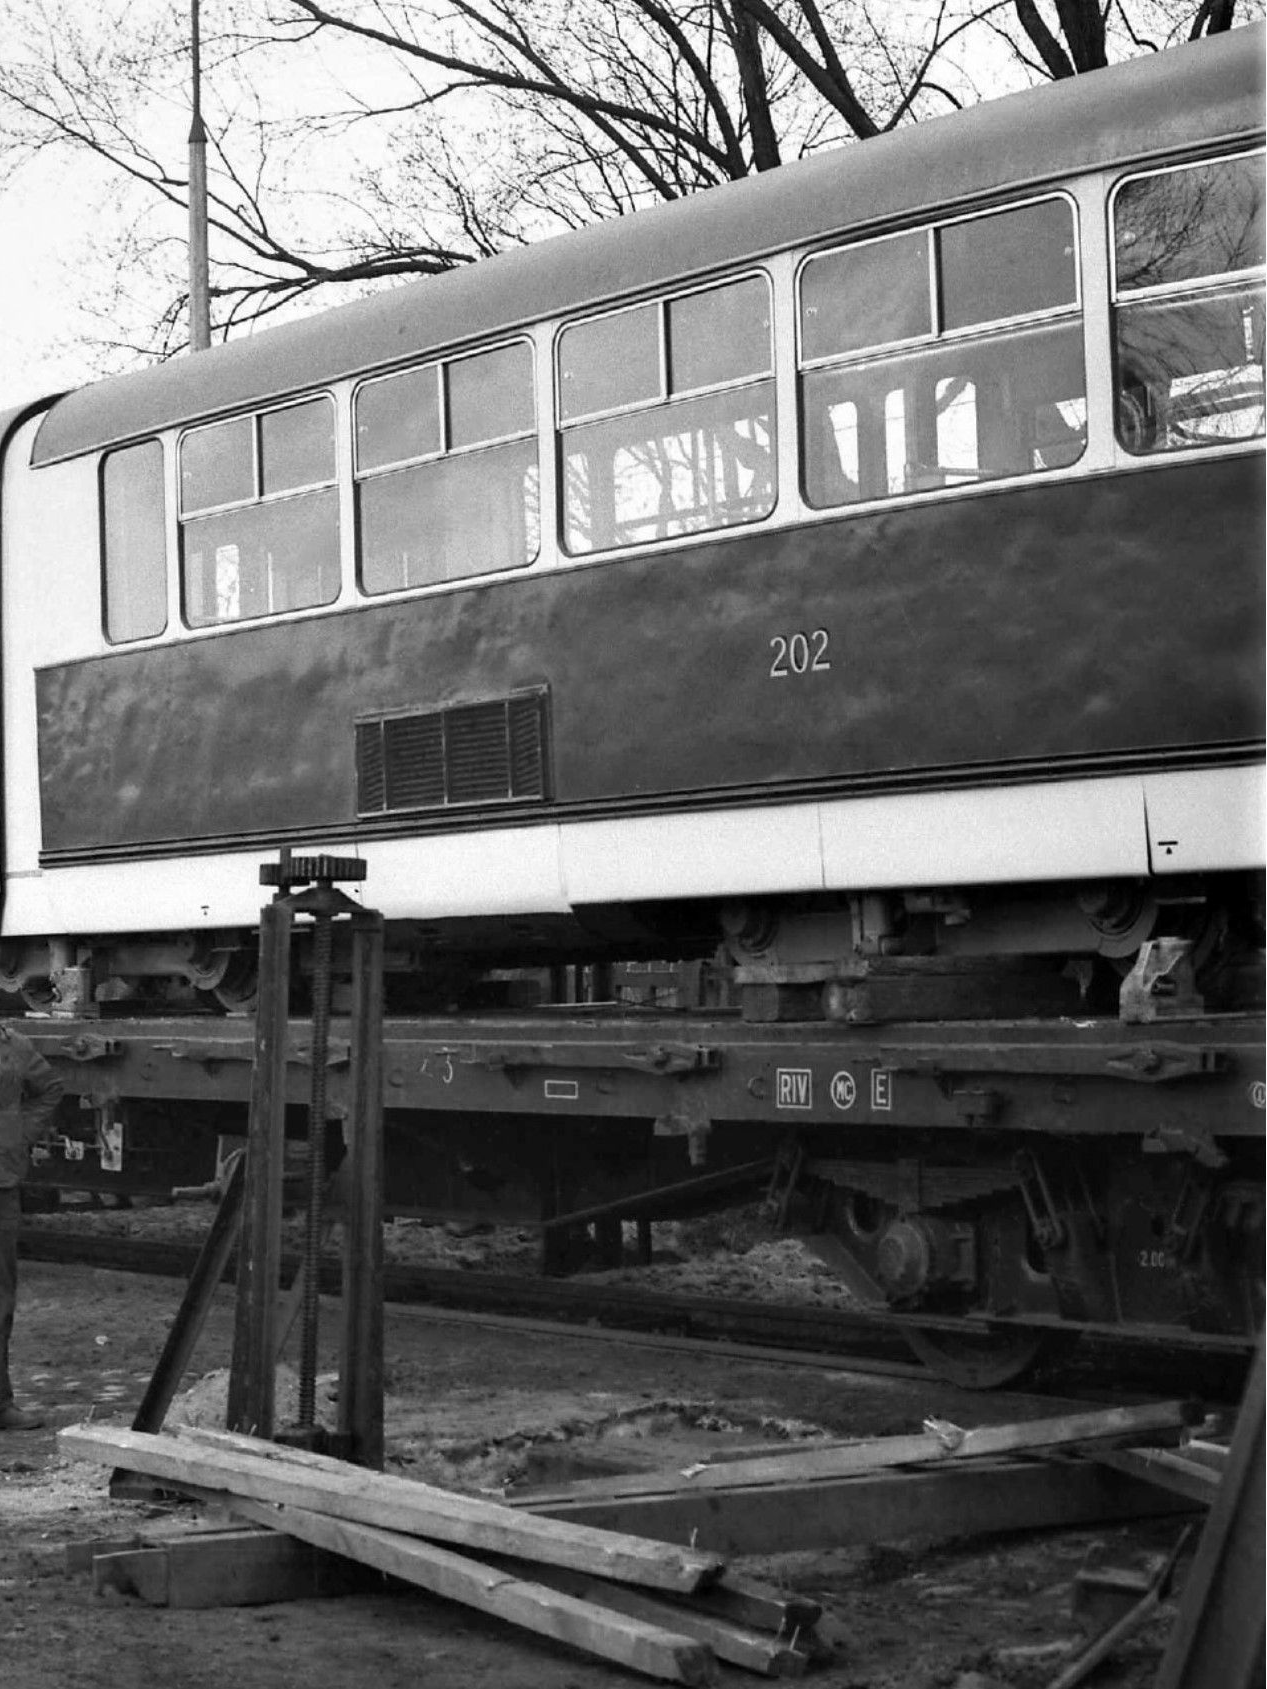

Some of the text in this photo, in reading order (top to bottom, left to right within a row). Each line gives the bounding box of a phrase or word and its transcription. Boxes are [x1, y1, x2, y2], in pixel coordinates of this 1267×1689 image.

[770, 629, 831, 677] 202
[780, 1074, 888, 1104] RIV MC E
